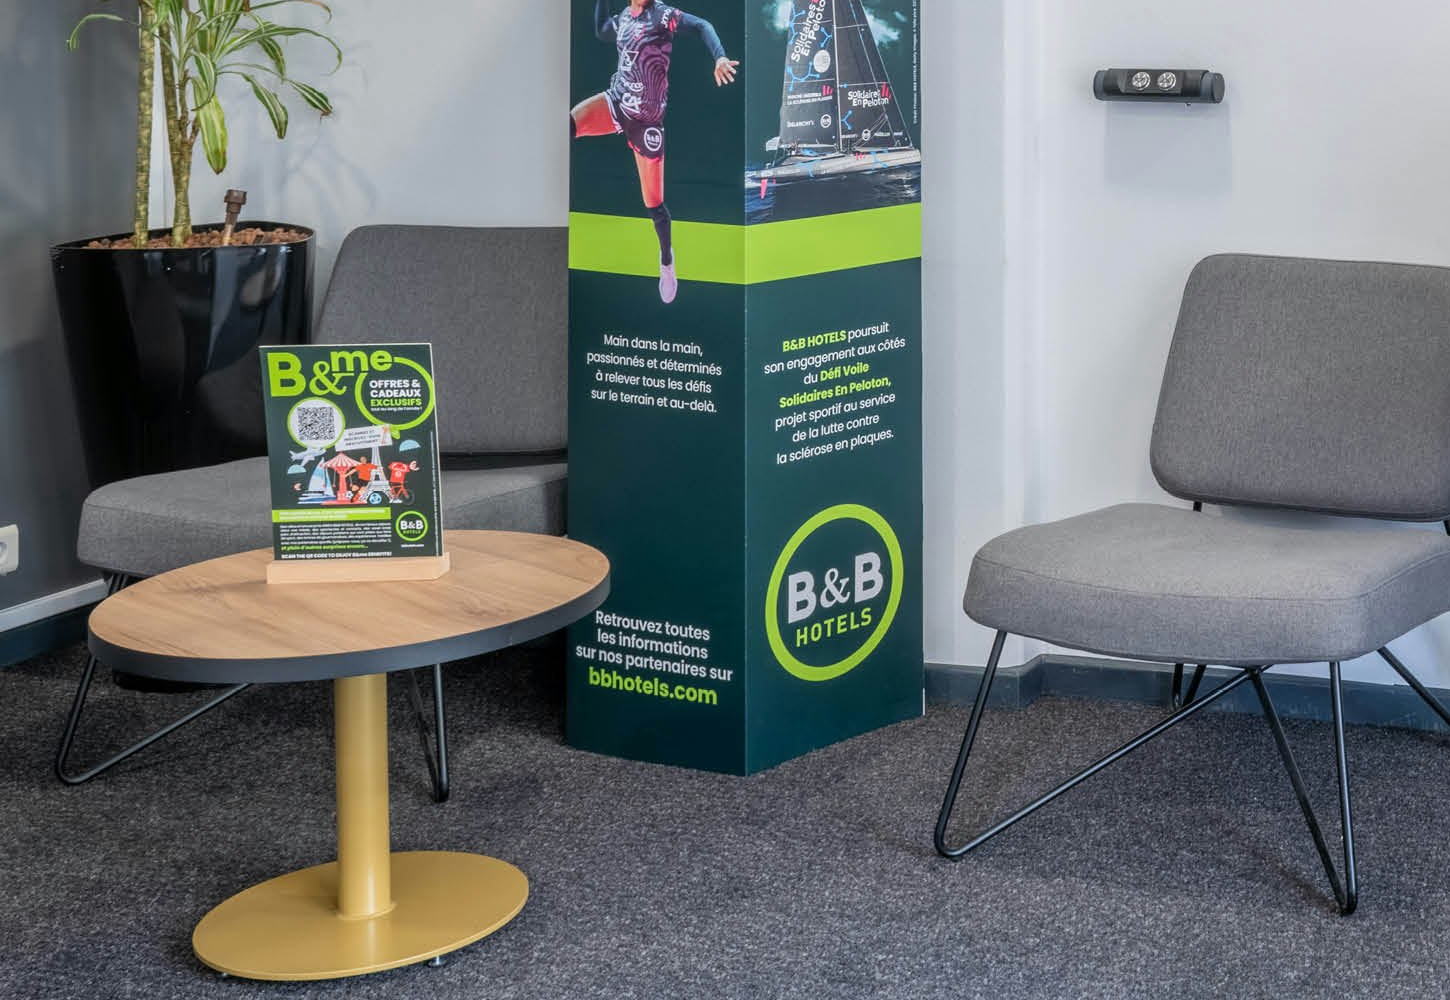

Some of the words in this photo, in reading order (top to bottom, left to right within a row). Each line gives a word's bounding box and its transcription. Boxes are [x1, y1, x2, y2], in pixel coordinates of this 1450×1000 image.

[604, 333, 628, 349] Main
[631, 337, 657, 351] dans
[660, 339, 670, 352] la
[673, 341, 703, 355] main,
[782, 336, 805, 352] B&B
[808, 330, 846, 349] HOTELS
[848, 322, 889, 343] poursuit
[587, 351, 644, 368] passionnés
[647, 356, 657, 368] et
[660, 357, 722, 375] déterminés
[764, 360, 784, 373] son
[787, 348, 855, 374] engagement
[857, 343, 876, 355] aux
[879, 337, 905, 352] côtés
[370, 380, 410, 388] OFFRES
[596, 370, 603, 381] à
[605, 373, 639, 387] relever
[643, 376, 664, 389] tous
[668, 377, 682, 390] les
[686, 379, 711, 393] défis
[803, 370, 818, 383] du
[820, 366, 840, 382] Défi
[843, 362, 869, 378] Voile
[370, 389, 421, 397] CADEAUX
[371, 398, 422, 406] EXCLUSIFS
[591, 387, 606, 399] sur
[609, 388, 617, 400] le
[620, 392, 654, 404] terrain
[656, 393, 667, 405] et
[670, 396, 717, 413] au-delà.
[779, 387, 833, 408] Solidaires
[835, 384, 848, 395] En
[850, 375, 891, 395] Peloton,
[775, 411, 806, 431] projet
[809, 404, 841, 424] sportif
[844, 402, 857, 414] au
[860, 392, 895, 411] service
[792, 428, 806, 442] de
[809, 426, 818, 438] la
[821, 420, 844, 436] lutte
[847, 414, 879, 431] contre
[777, 452, 787, 465] la
[789, 442, 832, 462] sclérose
[835, 440, 848, 452] en
[851, 428, 894, 453] plaques.
[401, 520, 423, 530] B&B
[787, 551, 884, 624] B&B
[595, 610, 662, 635] Retrouvez
[665, 621, 710, 640] toutes
[796, 607, 872, 647] HOTELS
[597, 629, 616, 644] les
[619, 631, 708, 660] informations
[576, 645, 596, 660] sur
[599, 648, 622, 664] nos
[625, 651, 706, 679] partenaires
[710, 667, 733, 681] sur
[589, 667, 718, 705] bbhotels.com
